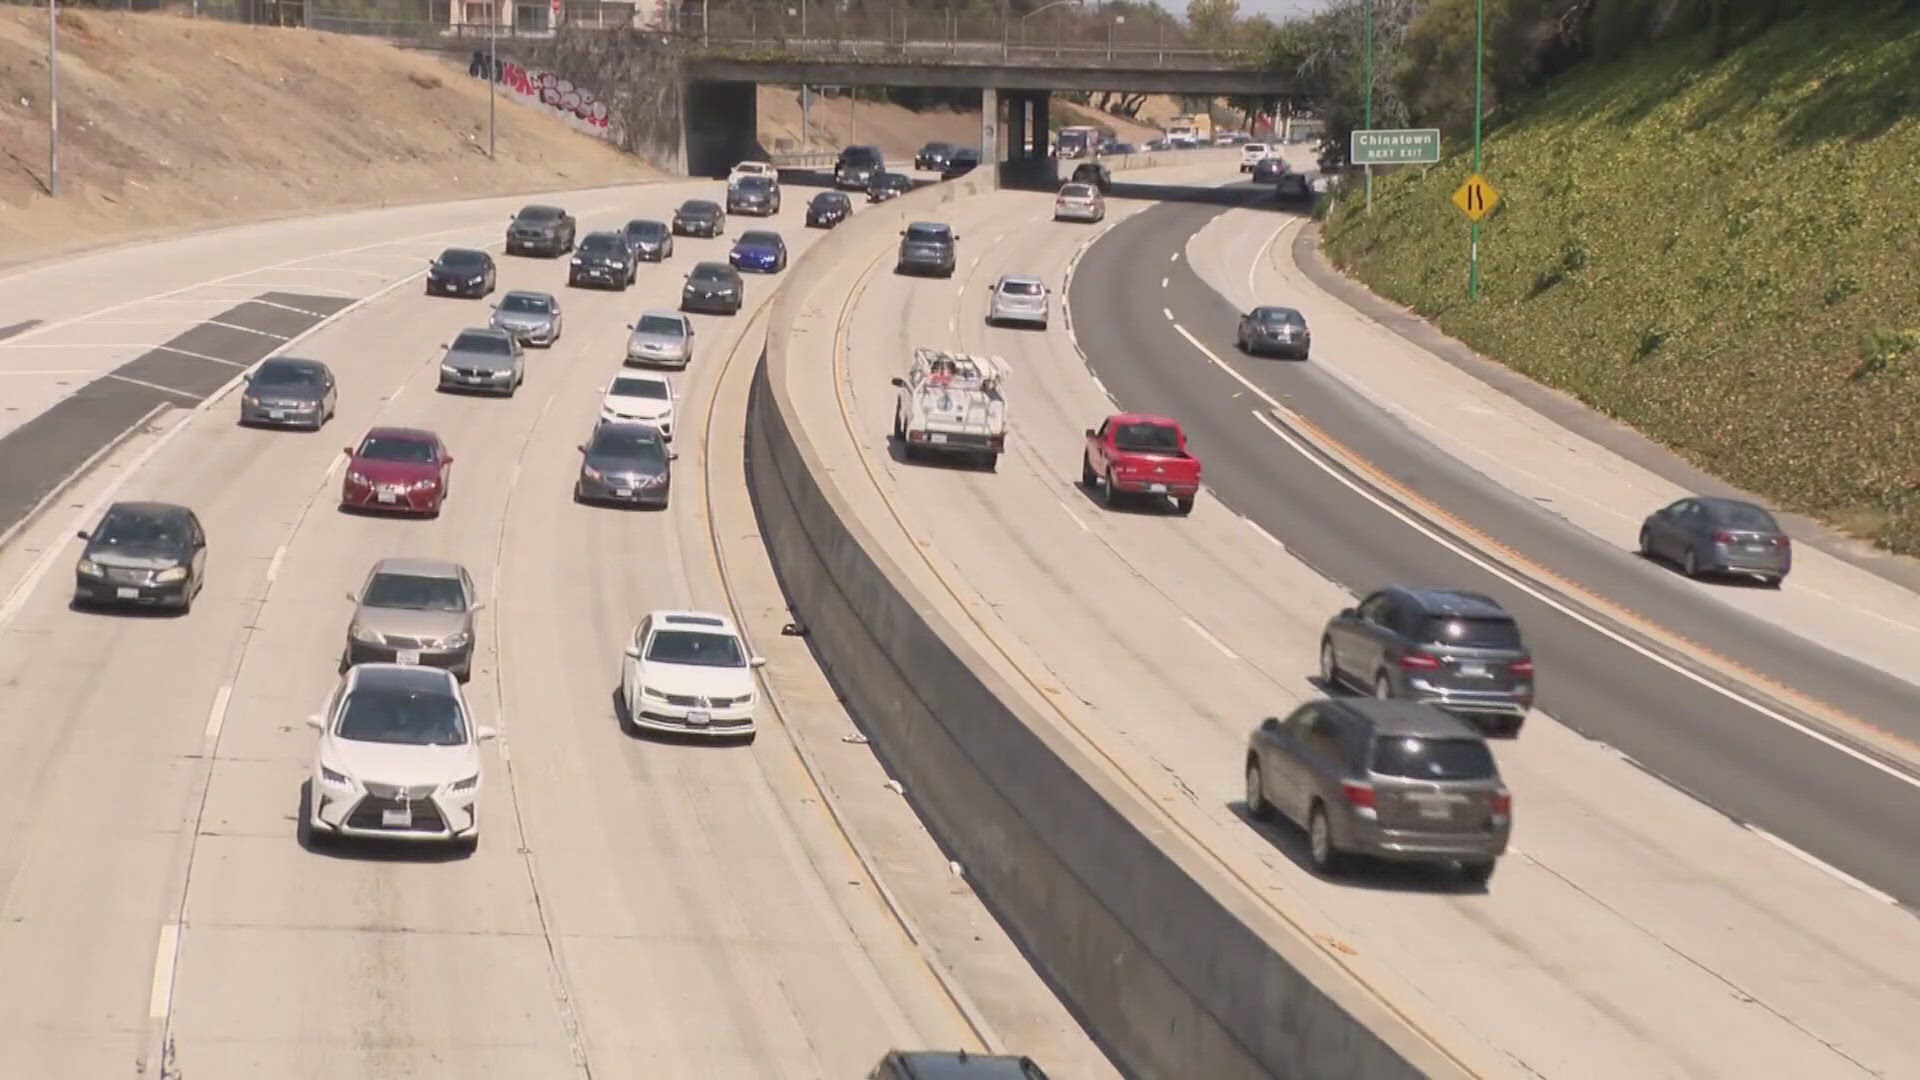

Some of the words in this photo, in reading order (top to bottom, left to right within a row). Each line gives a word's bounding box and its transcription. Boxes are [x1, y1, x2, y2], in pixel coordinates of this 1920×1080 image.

[1360, 135, 1431, 145] Chinatown
[1368, 149, 1394, 157] NEXT
[1400, 148, 1422, 157] EXIT
